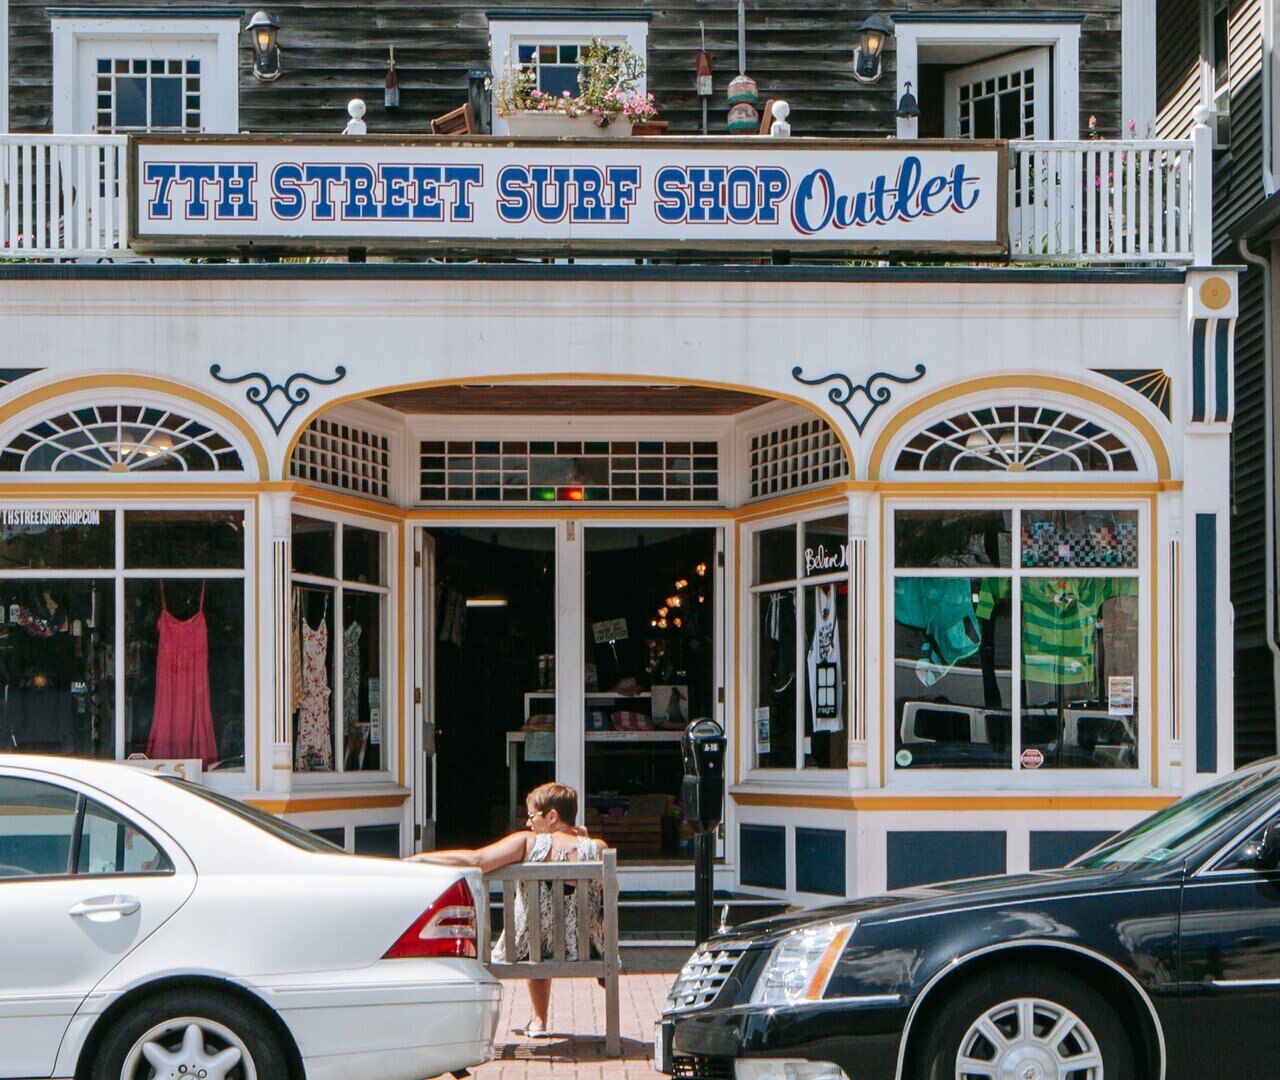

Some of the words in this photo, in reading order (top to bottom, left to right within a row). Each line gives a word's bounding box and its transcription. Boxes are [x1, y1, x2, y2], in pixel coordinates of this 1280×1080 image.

[144, 161, 258, 221] 7TH
[270, 162, 484, 223] STREET
[496, 164, 642, 224] SURF
[653, 166, 791, 225] SHOP
[791, 156, 981, 236] Outlet
